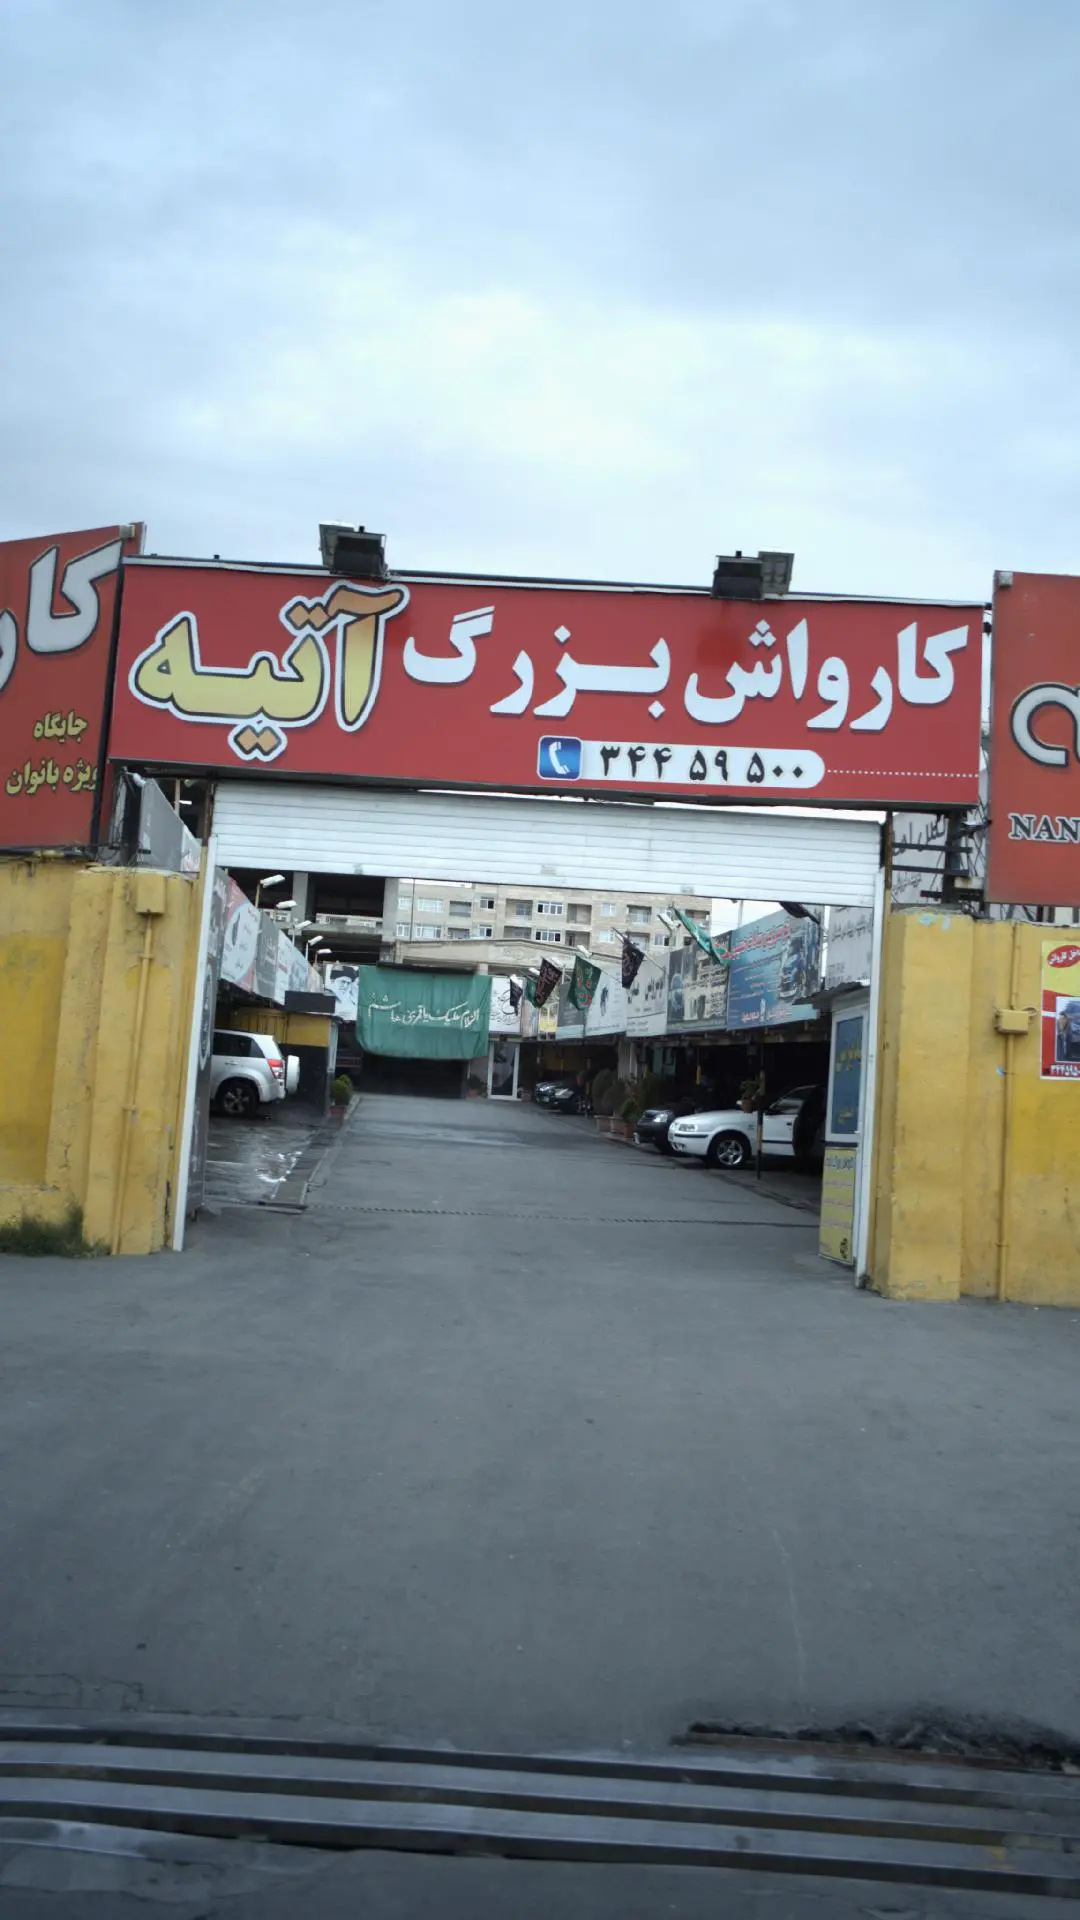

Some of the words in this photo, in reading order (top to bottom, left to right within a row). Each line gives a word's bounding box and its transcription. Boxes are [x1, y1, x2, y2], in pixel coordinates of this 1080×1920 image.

[129, 581, 410, 762] آتیه
[403, 606, 671, 719] بزرگ
[684, 618, 969, 731] کارواش
[5, 758, 60, 795] بانوان
[33, 709, 88, 744] جایگاه
